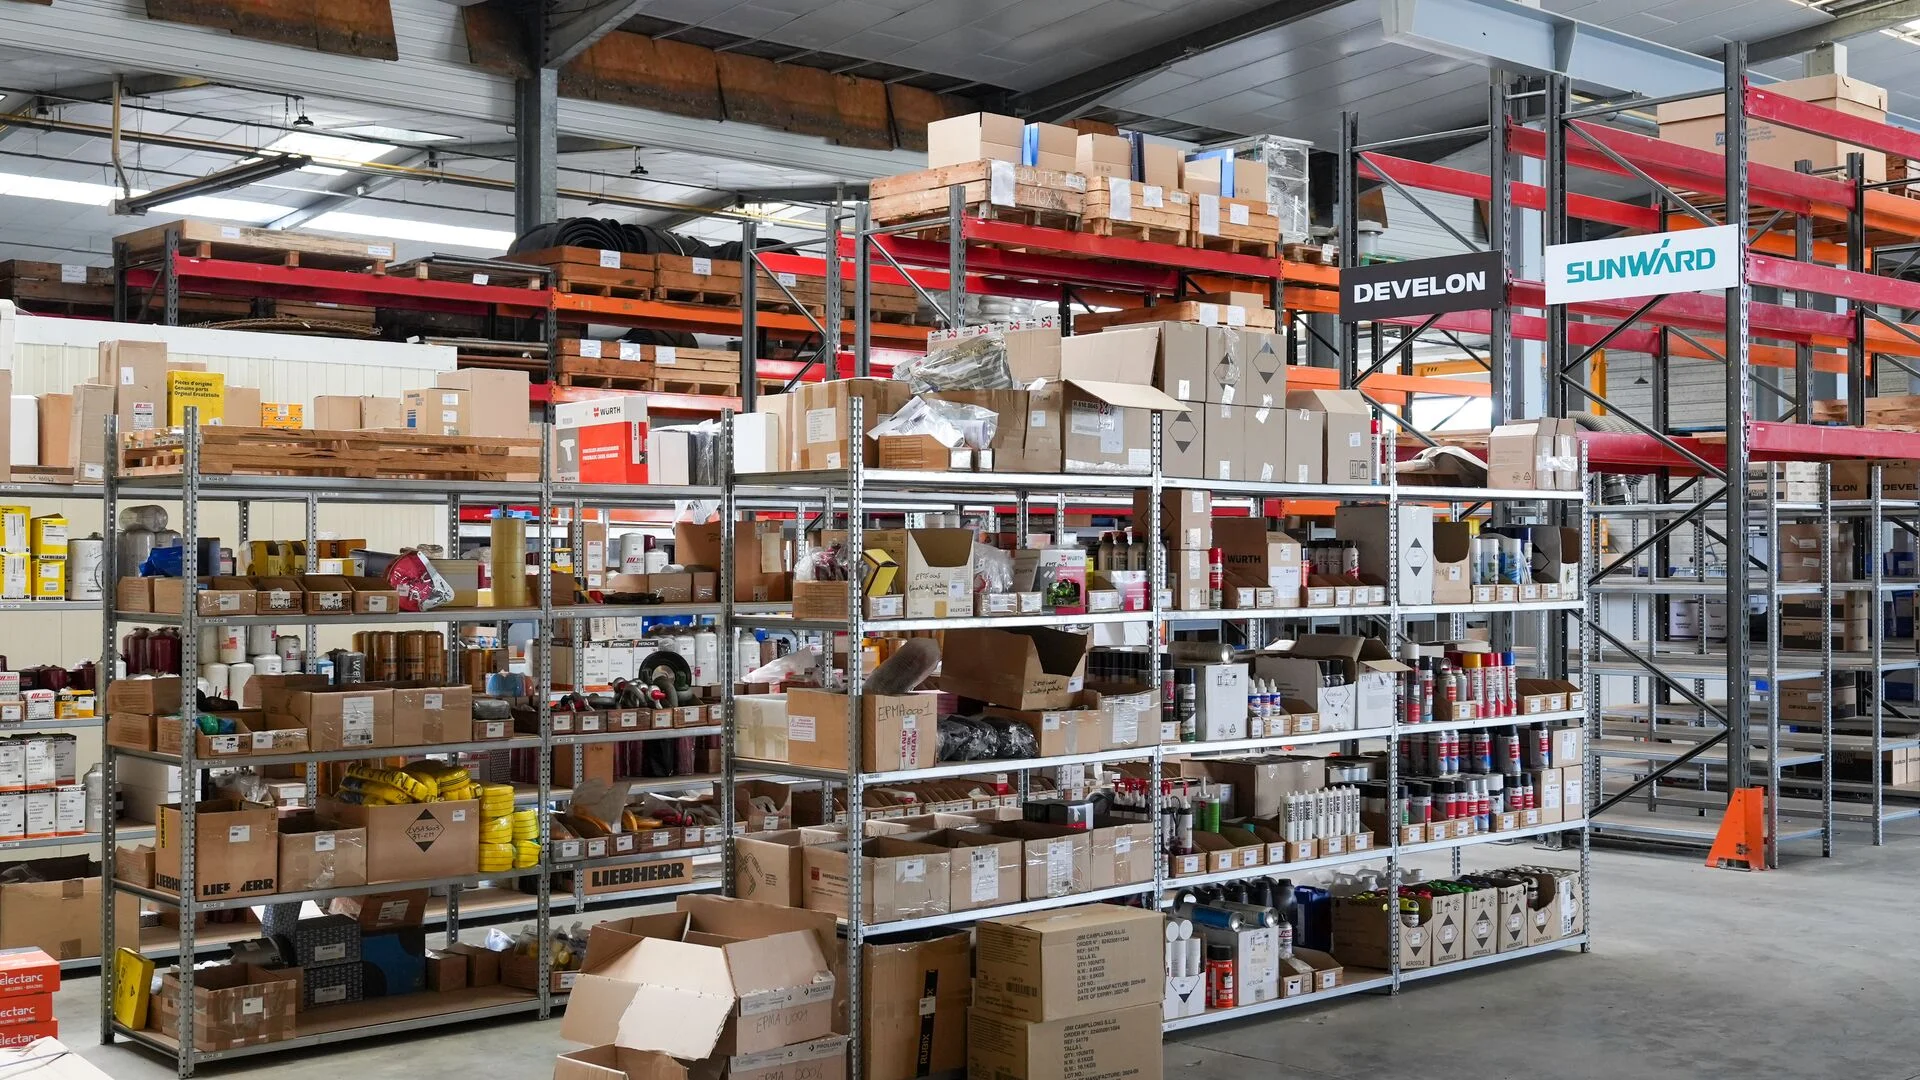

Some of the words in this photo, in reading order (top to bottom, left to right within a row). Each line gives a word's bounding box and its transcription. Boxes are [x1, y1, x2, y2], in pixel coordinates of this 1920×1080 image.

[1566, 239, 1715, 284] SUNWARD
[1353, 270, 1486, 303] DEVELON
[600, 407, 621, 416] WÜRTH
[1228, 554, 1261, 564] WÜRTH
[592, 863, 684, 887] LIEBHERR
[1438, 954, 1457, 962] AEROSOLS
[0, 973, 43, 986] electarc
[1077, 987, 1089, 995] DATE
[1096, 981, 1130, 991] MANUFACTURE:
[1077, 994, 1089, 1002] DATE
[816, 1041, 842, 1049] PROLIANS
[920, 1034, 930, 1065] RUBIX
